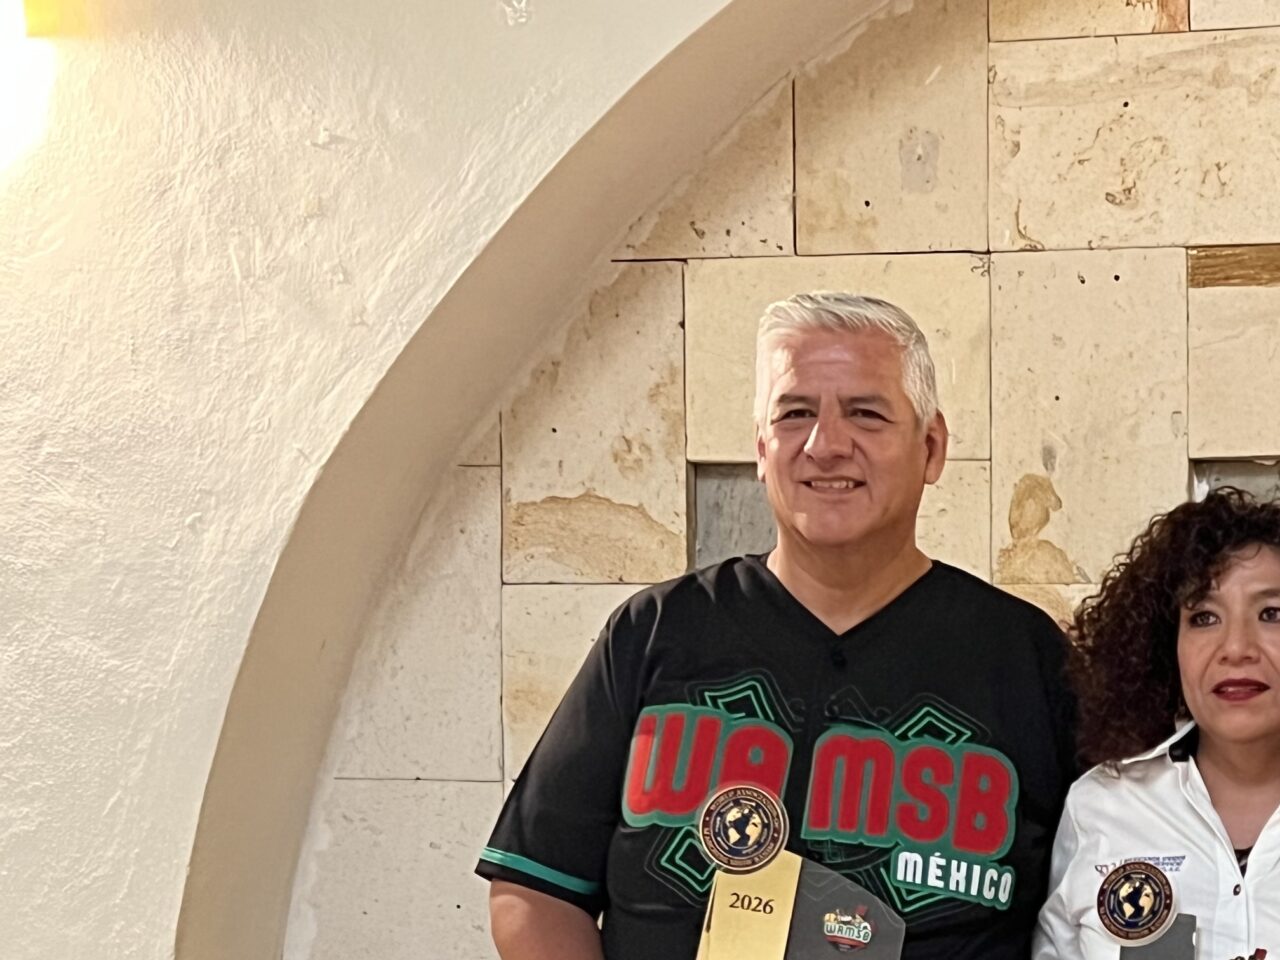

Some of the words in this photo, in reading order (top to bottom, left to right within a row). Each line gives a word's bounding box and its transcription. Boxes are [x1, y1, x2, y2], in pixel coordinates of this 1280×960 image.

[897, 850, 1013, 903] MÉXICO
[728, 892, 775, 915] 2026
[826, 923, 871, 942] WAMSB
